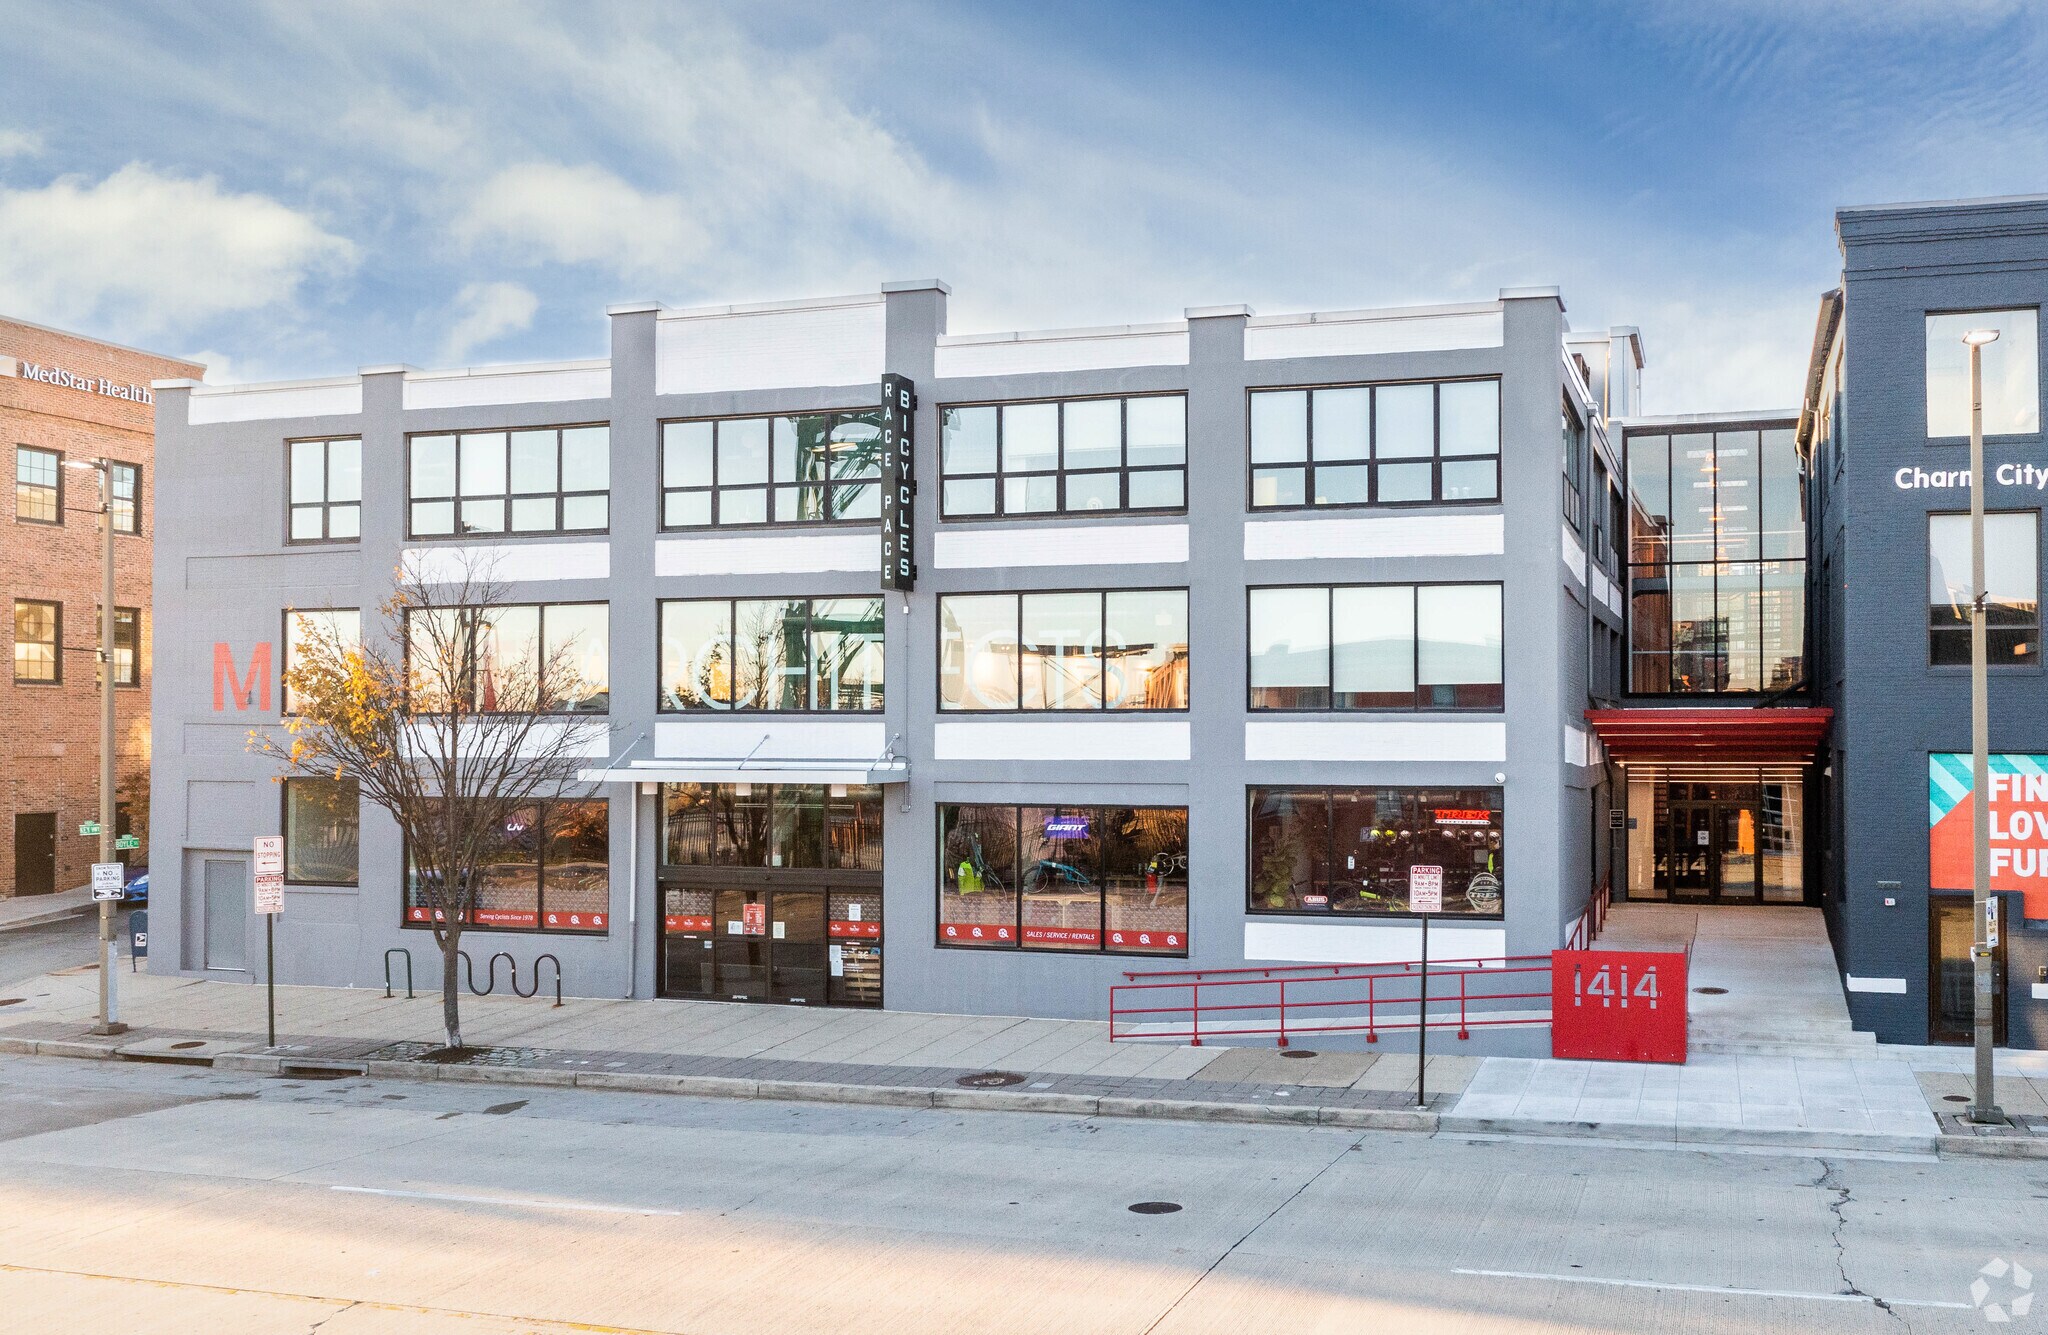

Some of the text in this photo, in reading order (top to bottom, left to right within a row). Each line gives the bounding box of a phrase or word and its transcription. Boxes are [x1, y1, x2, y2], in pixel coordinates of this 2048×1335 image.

[22, 361, 154, 404] MedStar Health
[884, 383, 892, 579] RACE PACE
[899, 390, 910, 577] BICYCLES
[1996, 463, 2048, 490] City
[213, 642, 271, 711] M
[1435, 809, 1491, 820] TREK
